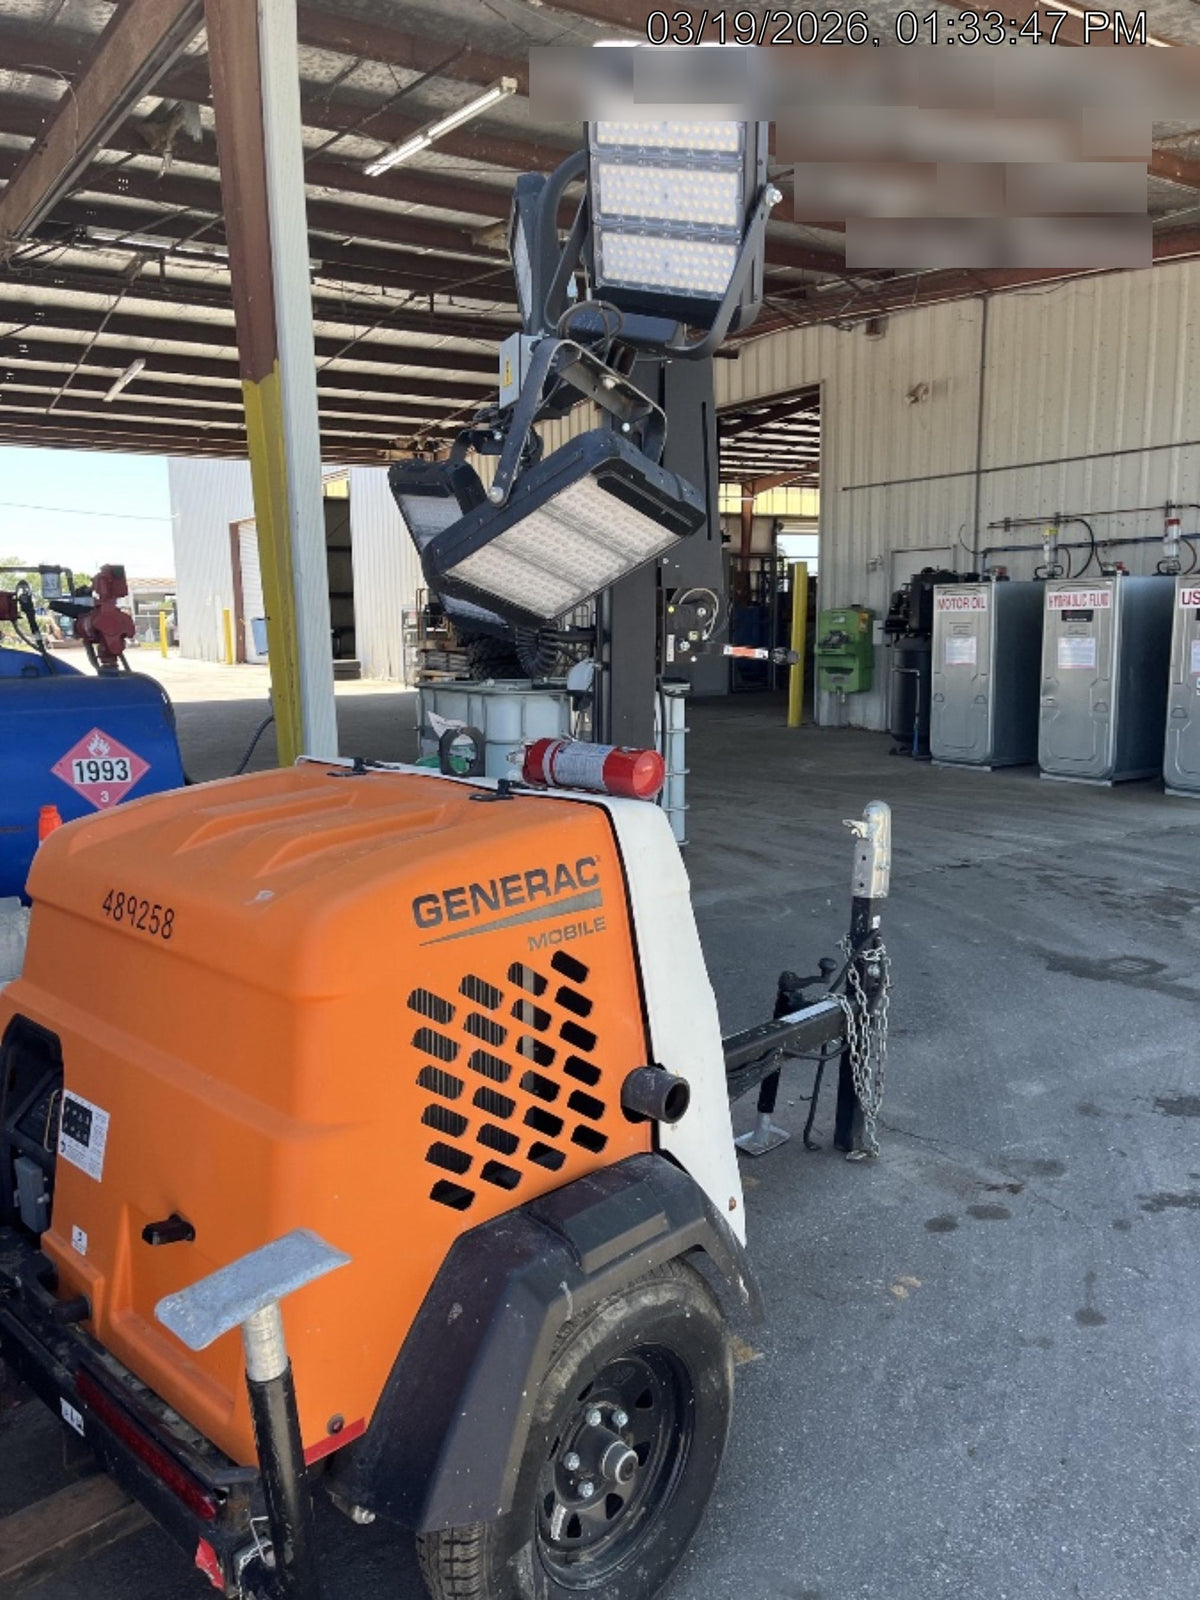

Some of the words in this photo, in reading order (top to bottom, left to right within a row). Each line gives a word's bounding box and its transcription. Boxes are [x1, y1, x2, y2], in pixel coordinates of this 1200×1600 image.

[938, 597, 970, 610] MOTOR
[971, 596, 986, 609] OIL
[74, 759, 129, 783] 1993
[100, 791, 110, 803] 3
[412, 856, 599, 929] GENERAC
[102, 889, 175, 939] 489258
[528, 916, 606, 951] MOBILE
